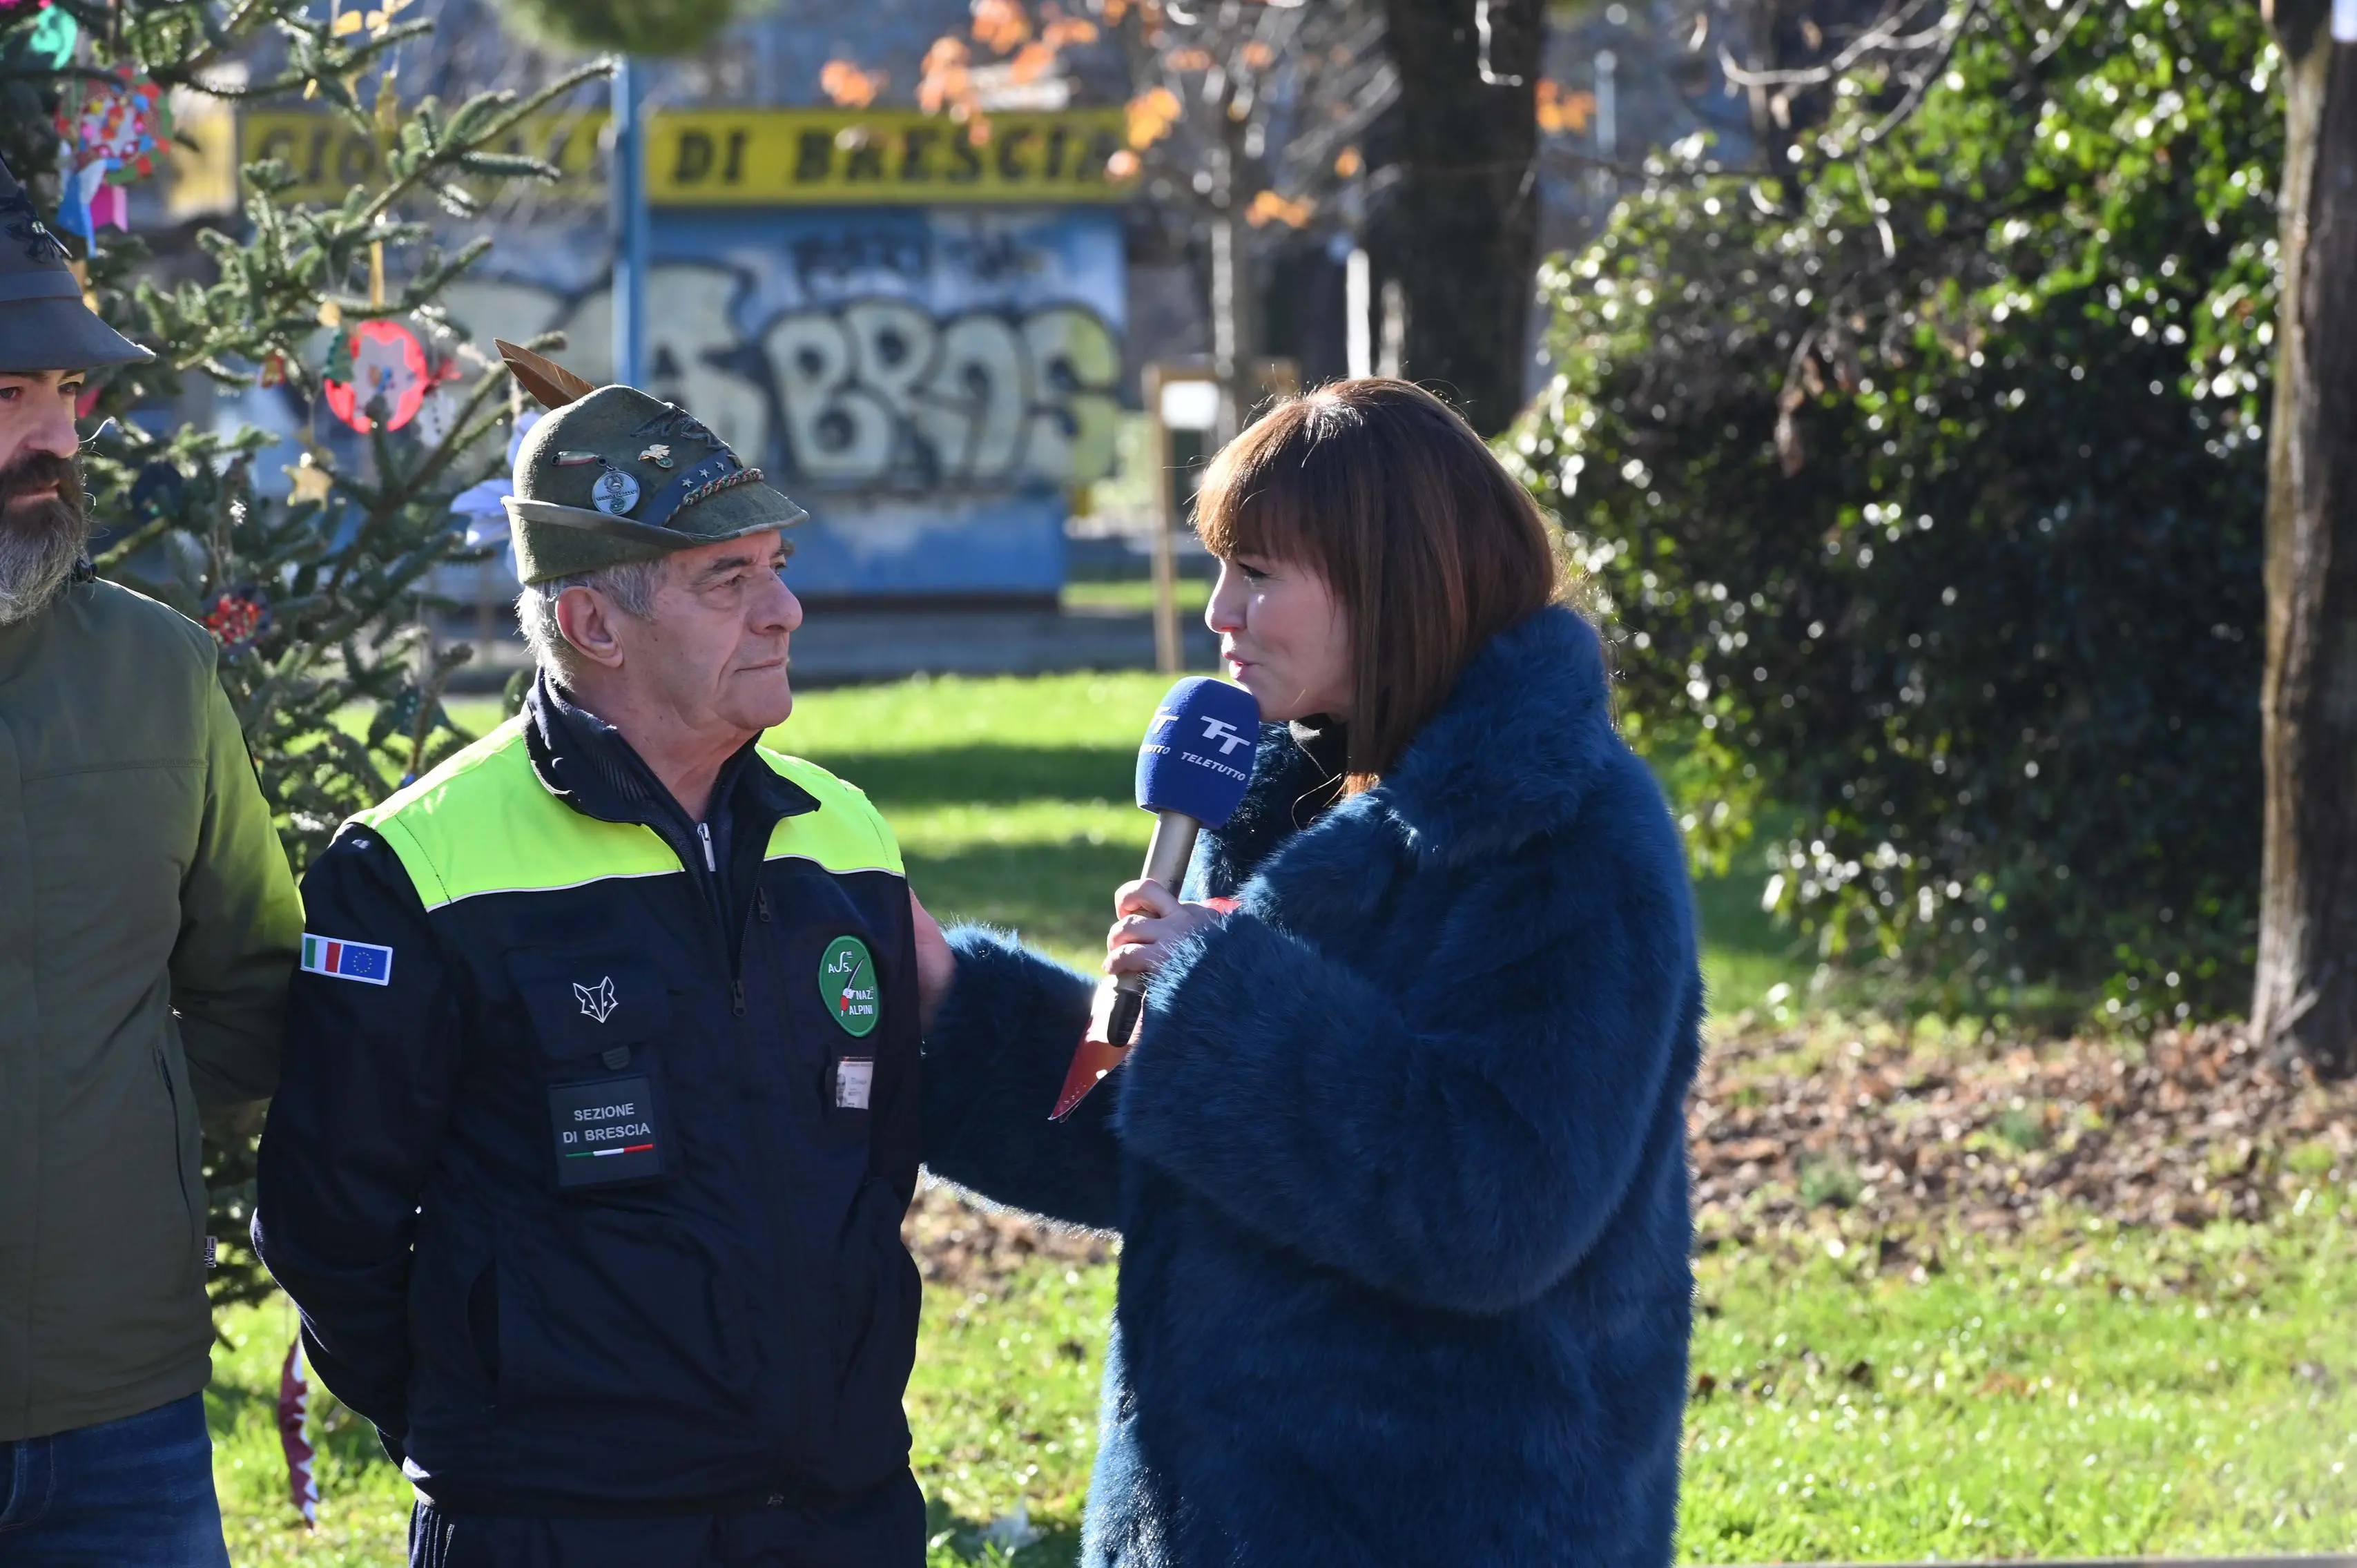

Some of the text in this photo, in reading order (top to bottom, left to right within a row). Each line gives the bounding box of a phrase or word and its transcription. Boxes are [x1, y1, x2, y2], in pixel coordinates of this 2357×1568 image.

[672, 127, 750, 185] DI
[1181, 751, 1245, 782] TELETUTTO
[848, 1005, 873, 1015] ALPINI
[574, 1103, 635, 1121] SEZIONE
[563, 1123, 651, 1143] DI BRESCIA
